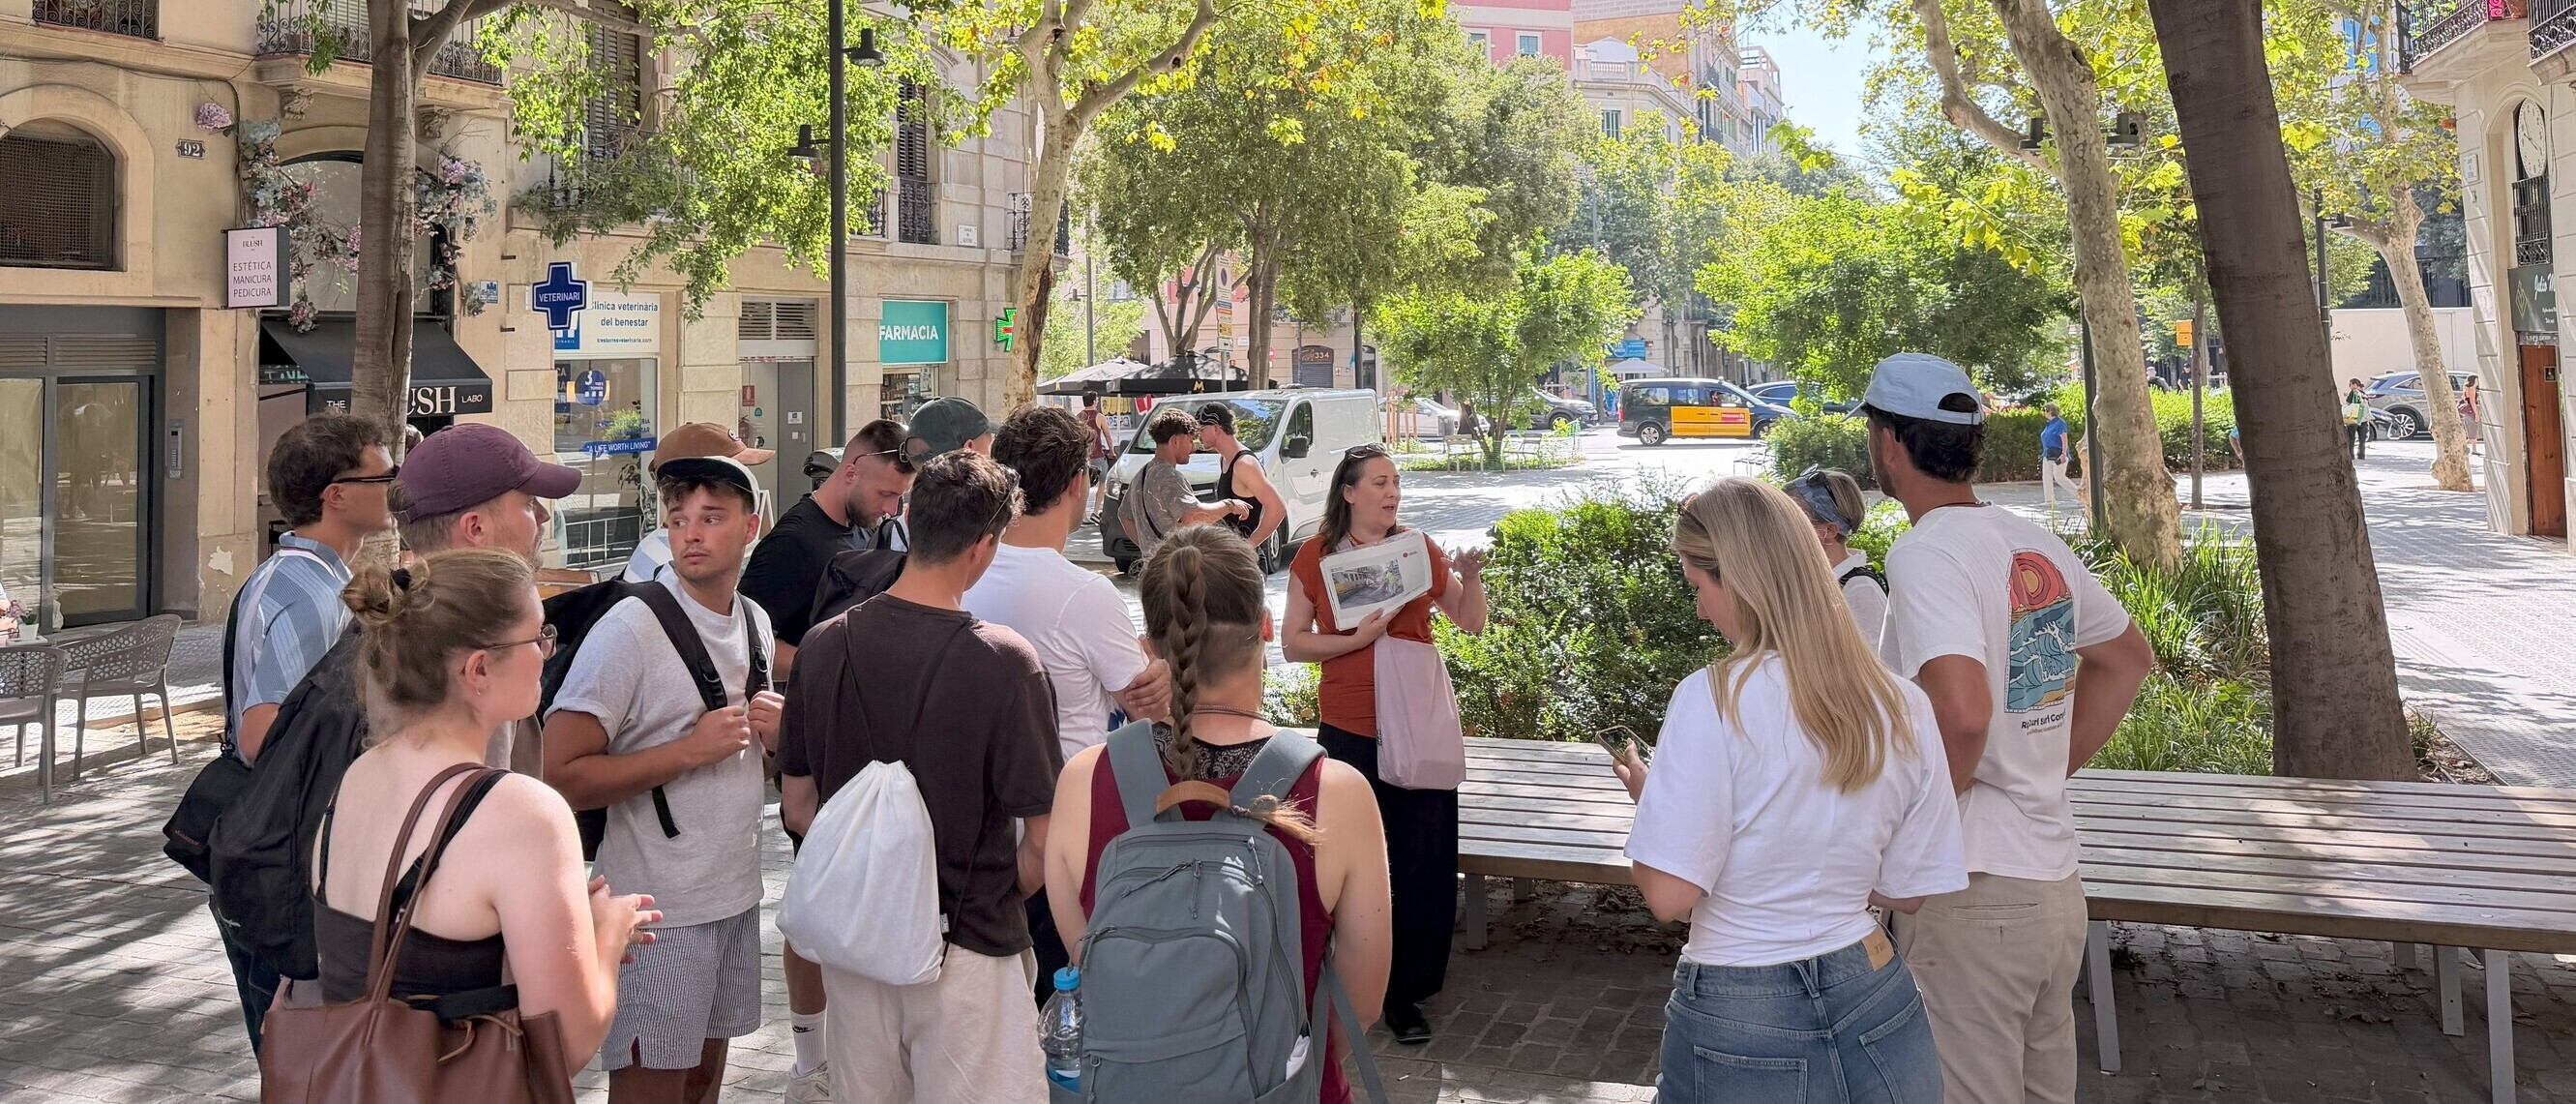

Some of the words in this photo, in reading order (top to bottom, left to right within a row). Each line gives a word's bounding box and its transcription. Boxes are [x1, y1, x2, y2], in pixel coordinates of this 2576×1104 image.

[184, 142, 200, 157] 92
[233, 260, 272, 272] ESTÉTICA
[233, 274, 272, 284] MANICURA
[233, 287, 272, 298] PEDICURA
[539, 291, 580, 303] VETERINARI
[617, 302, 659, 312] veterinària
[601, 317, 613, 327] del
[614, 317, 648, 327] benestar
[879, 324, 938, 341] FARMACIA
[326, 400, 345, 409] THE
[461, 394, 483, 403] LABO
[594, 444, 607, 453] LIFE
[608, 442, 630, 451] WORTH
